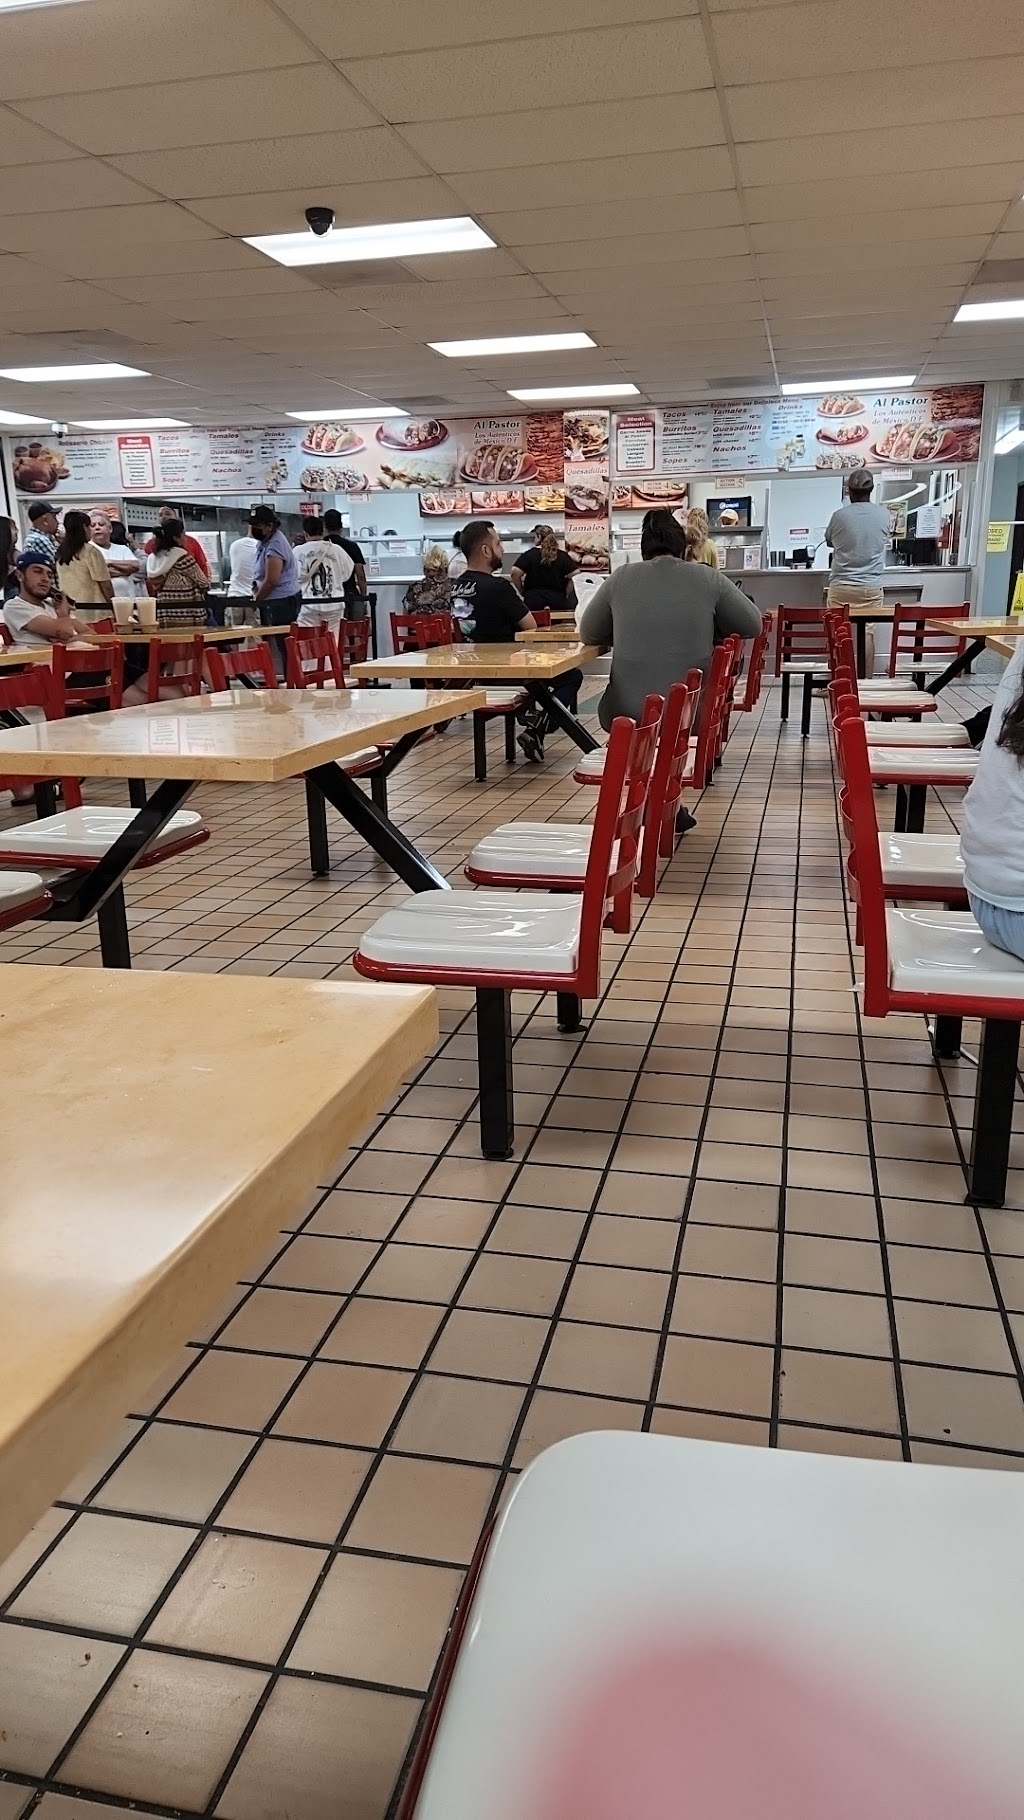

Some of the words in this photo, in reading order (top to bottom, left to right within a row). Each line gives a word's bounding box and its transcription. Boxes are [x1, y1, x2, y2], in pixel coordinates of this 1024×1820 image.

[873, 398, 886, 407] Al
[891, 397, 928, 406] Pastor
[713, 407, 747, 415] Tamales
[474, 421, 485, 430] Al
[489, 420, 521, 429] Pastor
[713, 424, 762, 433] Quesadillas
[210, 447, 254, 455] Quesadillas
[566, 467, 608, 476] Quesadillas
[568, 523, 605, 532] Tamales
